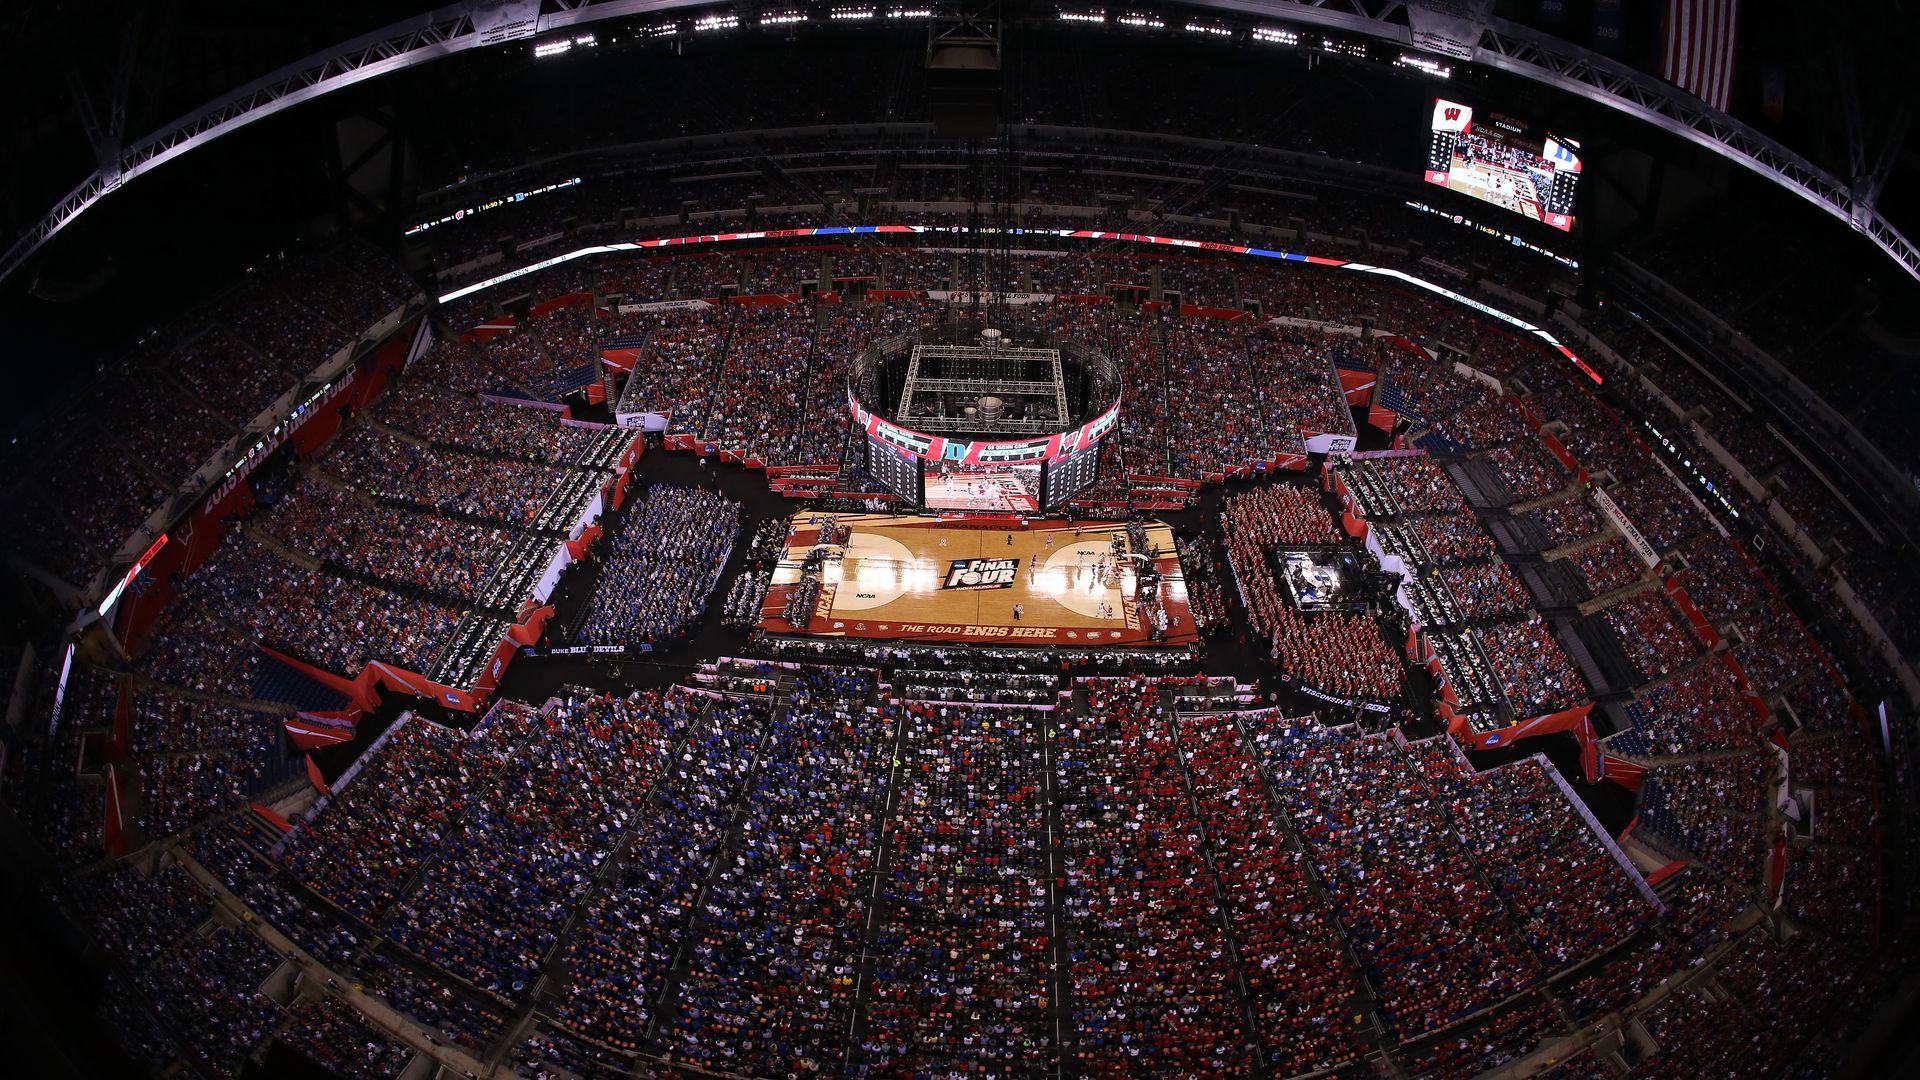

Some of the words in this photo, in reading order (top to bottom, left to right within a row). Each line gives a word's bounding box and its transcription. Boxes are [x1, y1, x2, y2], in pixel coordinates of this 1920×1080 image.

[1543, 0, 1562, 11] 2000
[1597, 26, 1619, 39] 2006
[1496, 121, 1522, 133] STADIUM
[482, 202, 499, 211] 16:50
[748, 231, 765, 239] ROAD
[979, 226, 996, 234] 16:50
[1479, 225, 1496, 236] 16:50
[492, 268, 530, 285] WISCONSIN
[537, 261, 554, 270] DUKE
[1453, 294, 1490, 314] WISCONSIN
[1497, 311, 1515, 324] DUKE
[944, 442, 966, 461] D
[1014, 442, 1029, 450] COOK
[933, 523, 1030, 532] INDIANAPOLIS
[1602, 496, 1614, 511] 2015
[1613, 508, 1628, 526] NCAA
[1626, 524, 1640, 543] FINAL
[1639, 541, 1653, 558] FOUR
[969, 560, 1015, 572] FINAL
[948, 568, 1015, 587] FOUR
[816, 585, 836, 621] NCAA
[1124, 601, 1141, 632] FOUR
[899, 624, 925, 633] THE
[926, 625, 961, 633] ROAD
[962, 626, 1009, 637] ENDS
[1010, 627, 1057, 638] HERE.
[569, 646, 587, 654] BLU
[593, 645, 625, 654] DEVILS
[1300, 685, 1346, 706] WISCONSIN
[1344, 698, 1391, 713] BGERS
